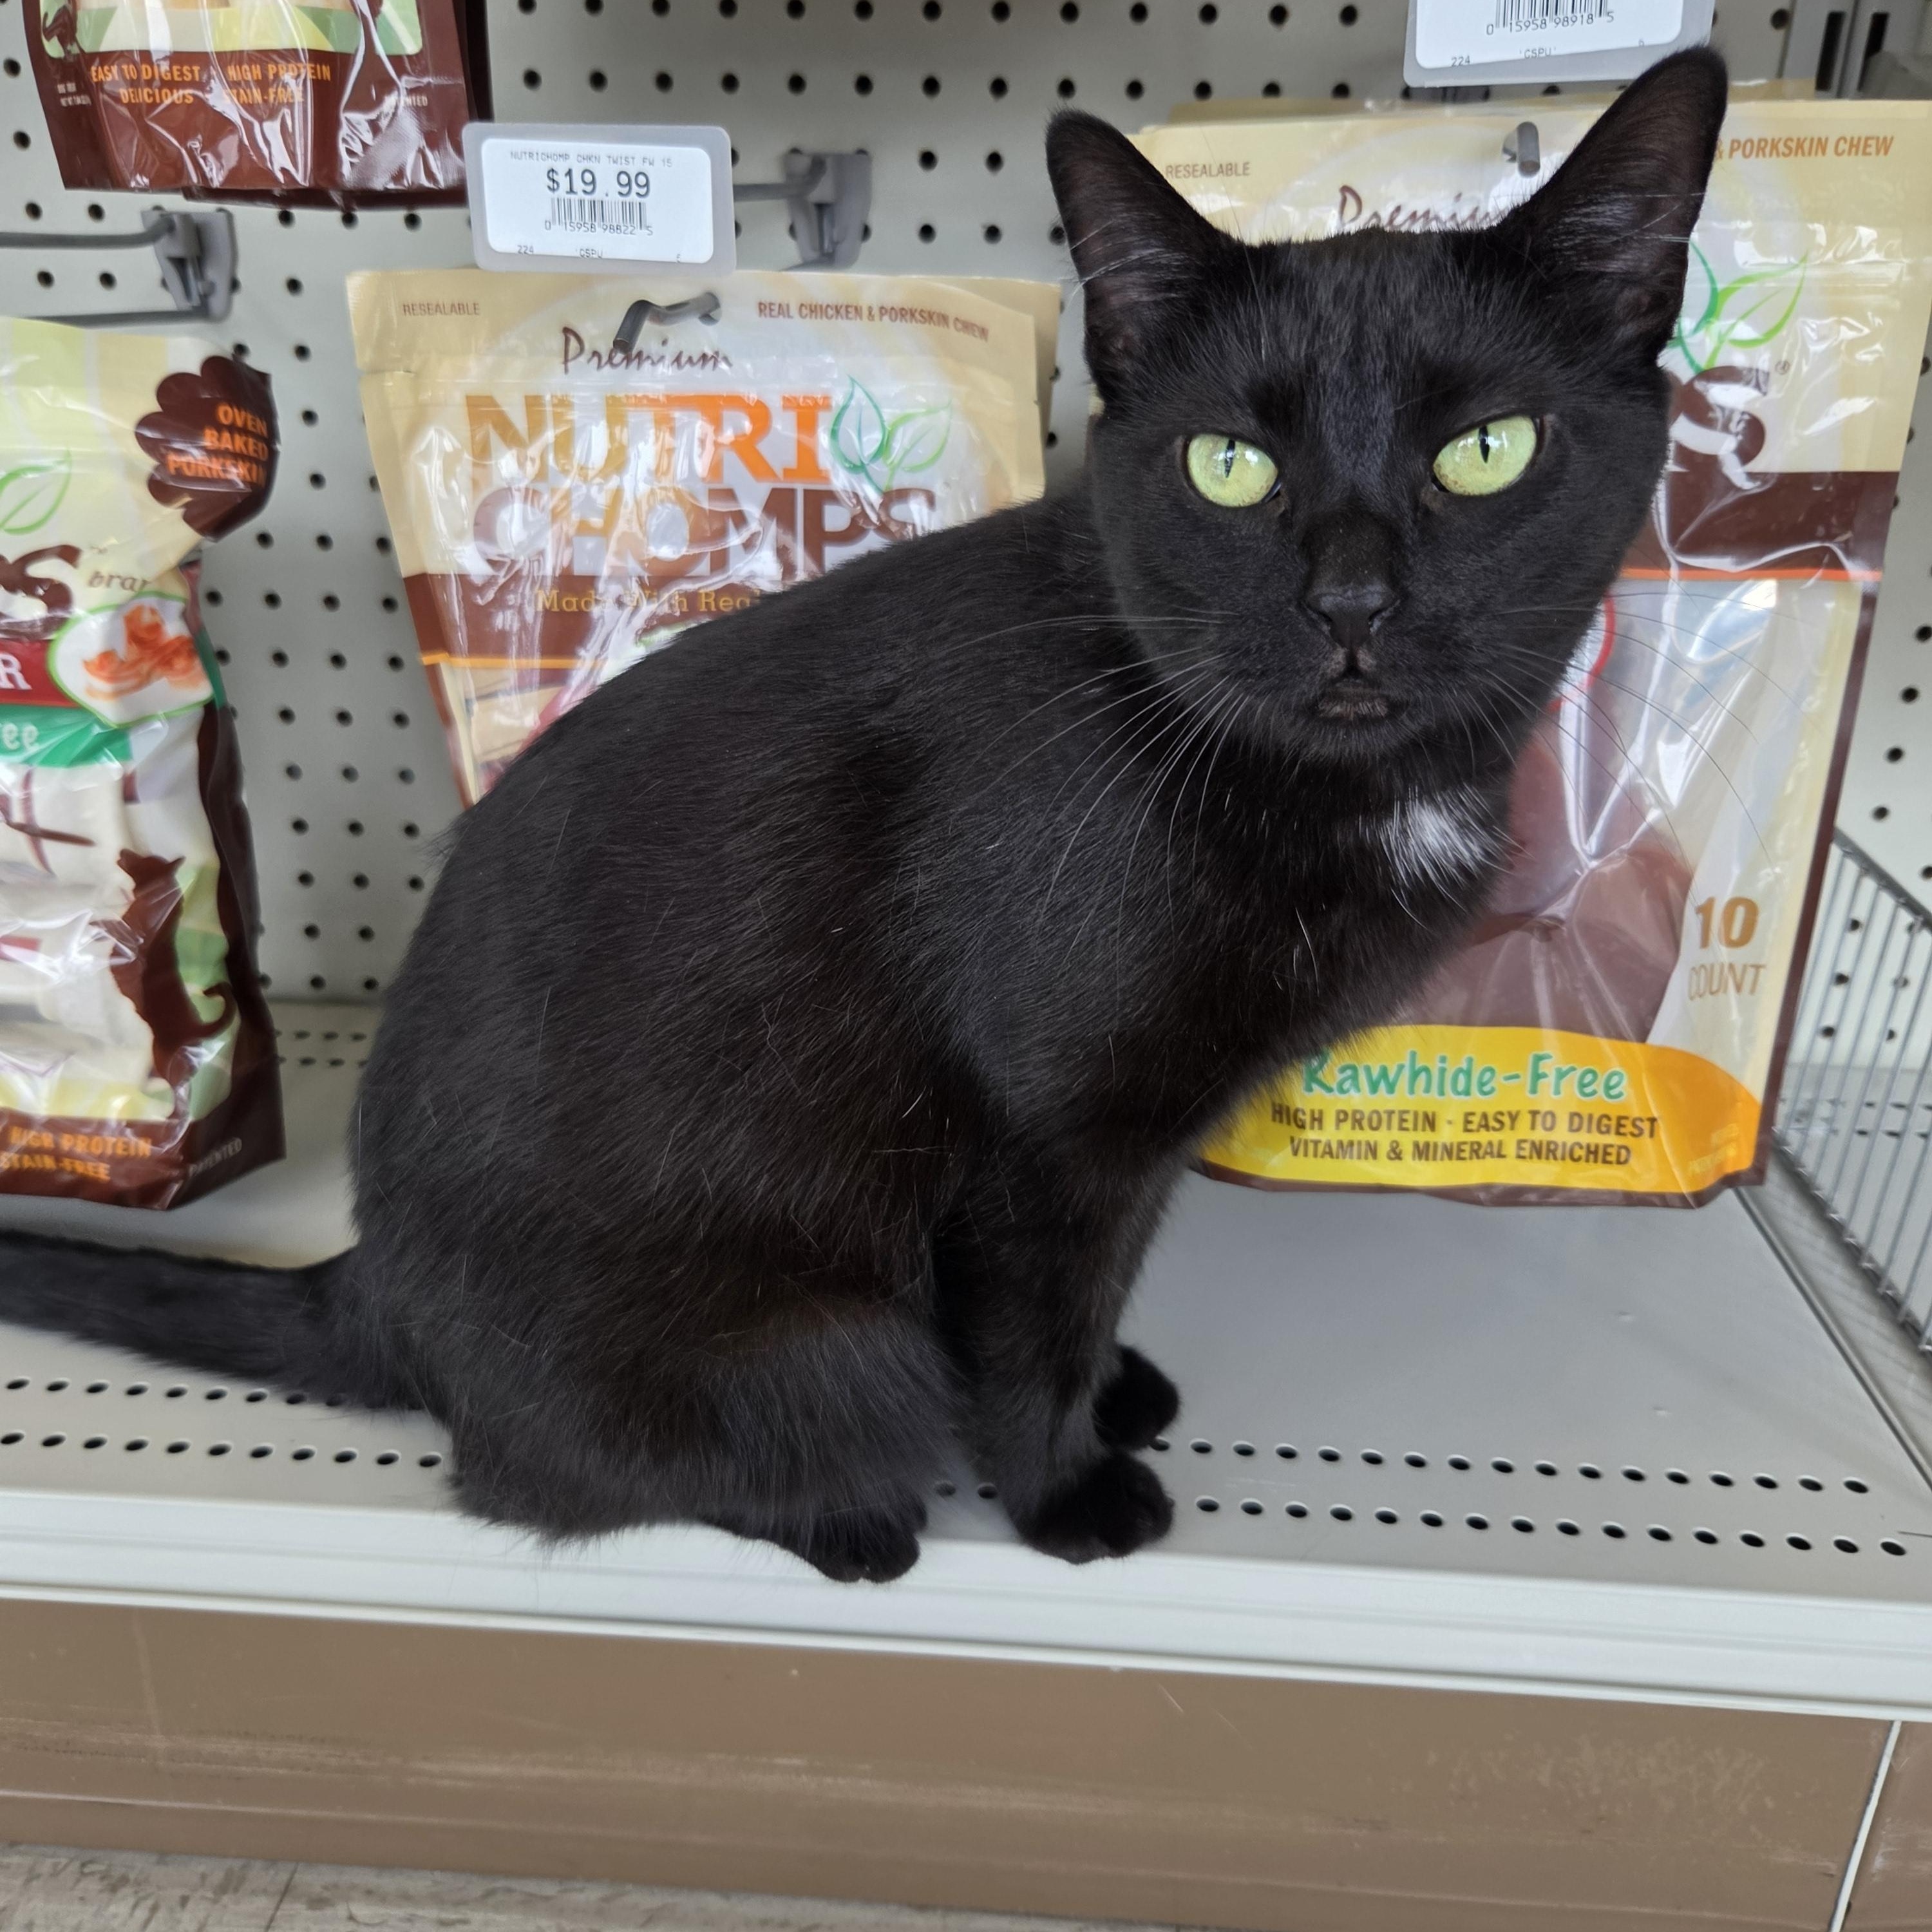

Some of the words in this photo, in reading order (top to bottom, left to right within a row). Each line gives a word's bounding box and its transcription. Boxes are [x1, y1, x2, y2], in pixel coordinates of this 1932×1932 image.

[1486, 24, 1494, 35] 0
[1510, 18, 1547, 32] 15958
[1553, 13, 1595, 28] 98918
[1607, 11, 1615, 23] 5
[91, 64, 118, 82] EASY
[122, 64, 137, 80] TO
[142, 63, 201, 82] DIGEST
[227, 64, 263, 81] HIGH
[267, 63, 331, 82] PROTEIN
[1450, 56, 1471, 67] 224
[119, 88, 194, 104] DELICIOUS
[608, 155, 636, 166] TWIST
[1728, 136, 1829, 160] PORKSKIN
[1834, 135, 1895, 158] CHEW
[546, 167, 651, 198] $19.99
[1165, 161, 1251, 179] RESEALABLE
[544, 220, 551, 231] 0
[564, 221, 597, 234] 15958
[602, 223, 636, 235] 98822
[646, 225, 654, 236] 5
[402, 301, 480, 317] RESEALABLE
[757, 301, 794, 319] REAL
[797, 303, 864, 321] CHICKEN
[867, 305, 876, 322] &
[878, 305, 951, 329] PORKSKIN
[952, 316, 990, 343] CHEW
[562, 325, 733, 376] Premium
[217, 402, 267, 438] OVEN
[203, 424, 269, 462] BAKED
[464, 393, 832, 486] NUTRI
[1695, 896, 1759, 949] 10
[1689, 962, 1767, 1001] COUNT
[1271, 1101, 1324, 1131] HIGH
[1334, 1108, 1436, 1132] PROTEIN
[1462, 1110, 1521, 1133] EASY
[1528, 1109, 1557, 1132] TO
[1567, 1111, 1660, 1139] DIGEST
[61, 1132, 152, 1159] PROTEIN
[1289, 1135, 1378, 1160] VITAMIN
[1386, 1139, 1403, 1161] &
[1411, 1139, 1508, 1162] MINERAL
[1515, 1138, 1632, 1165] ENRICHED
